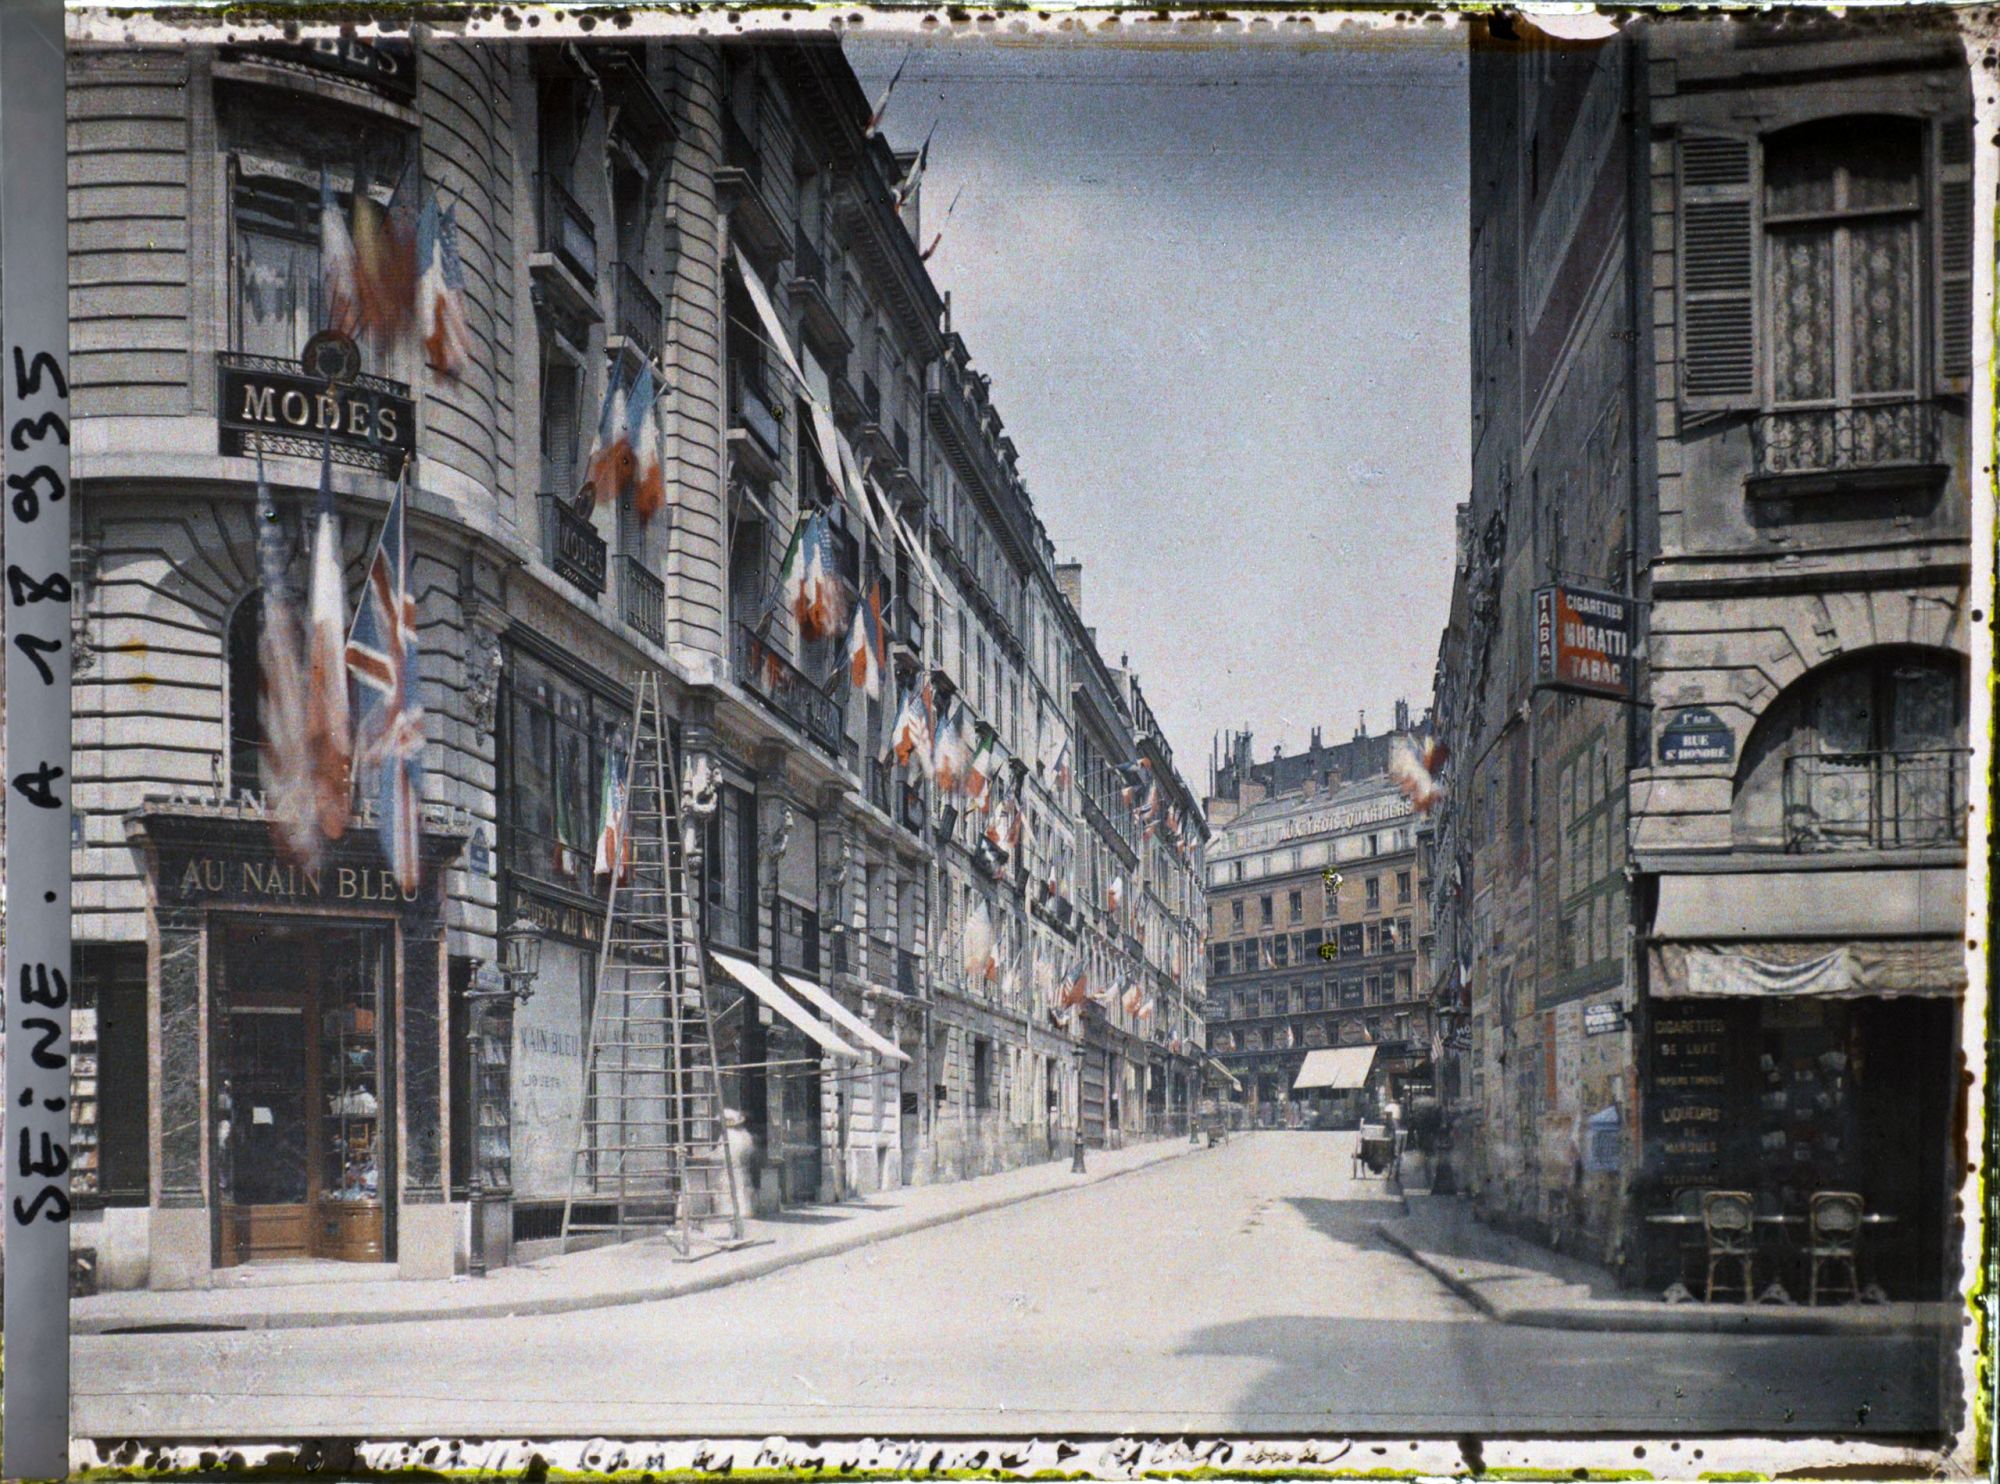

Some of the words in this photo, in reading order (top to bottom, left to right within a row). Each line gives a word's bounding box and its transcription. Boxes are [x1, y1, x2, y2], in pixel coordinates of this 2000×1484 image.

[241, 384, 398, 442] MODES
[7, 345, 71, 523] 935
[1566, 594, 1624, 620] CIGARETTES
[7, 564, 72, 686] 18
[1538, 594, 1551, 674] TABAC
[1564, 622, 1628, 657] MURATTI
[1570, 655, 1621, 685] TABAC
[1682, 734, 1709, 746] RUE
[12, 761, 64, 809] A
[1307, 810, 1342, 834] TROIS
[180, 859, 225, 893] AU
[242, 862, 321, 896] NAIN
[337, 868, 420, 902] BLEU
[1655, 1019, 1725, 1034] CIGARETTES
[1661, 1106, 1720, 1123] LIQUEURS
